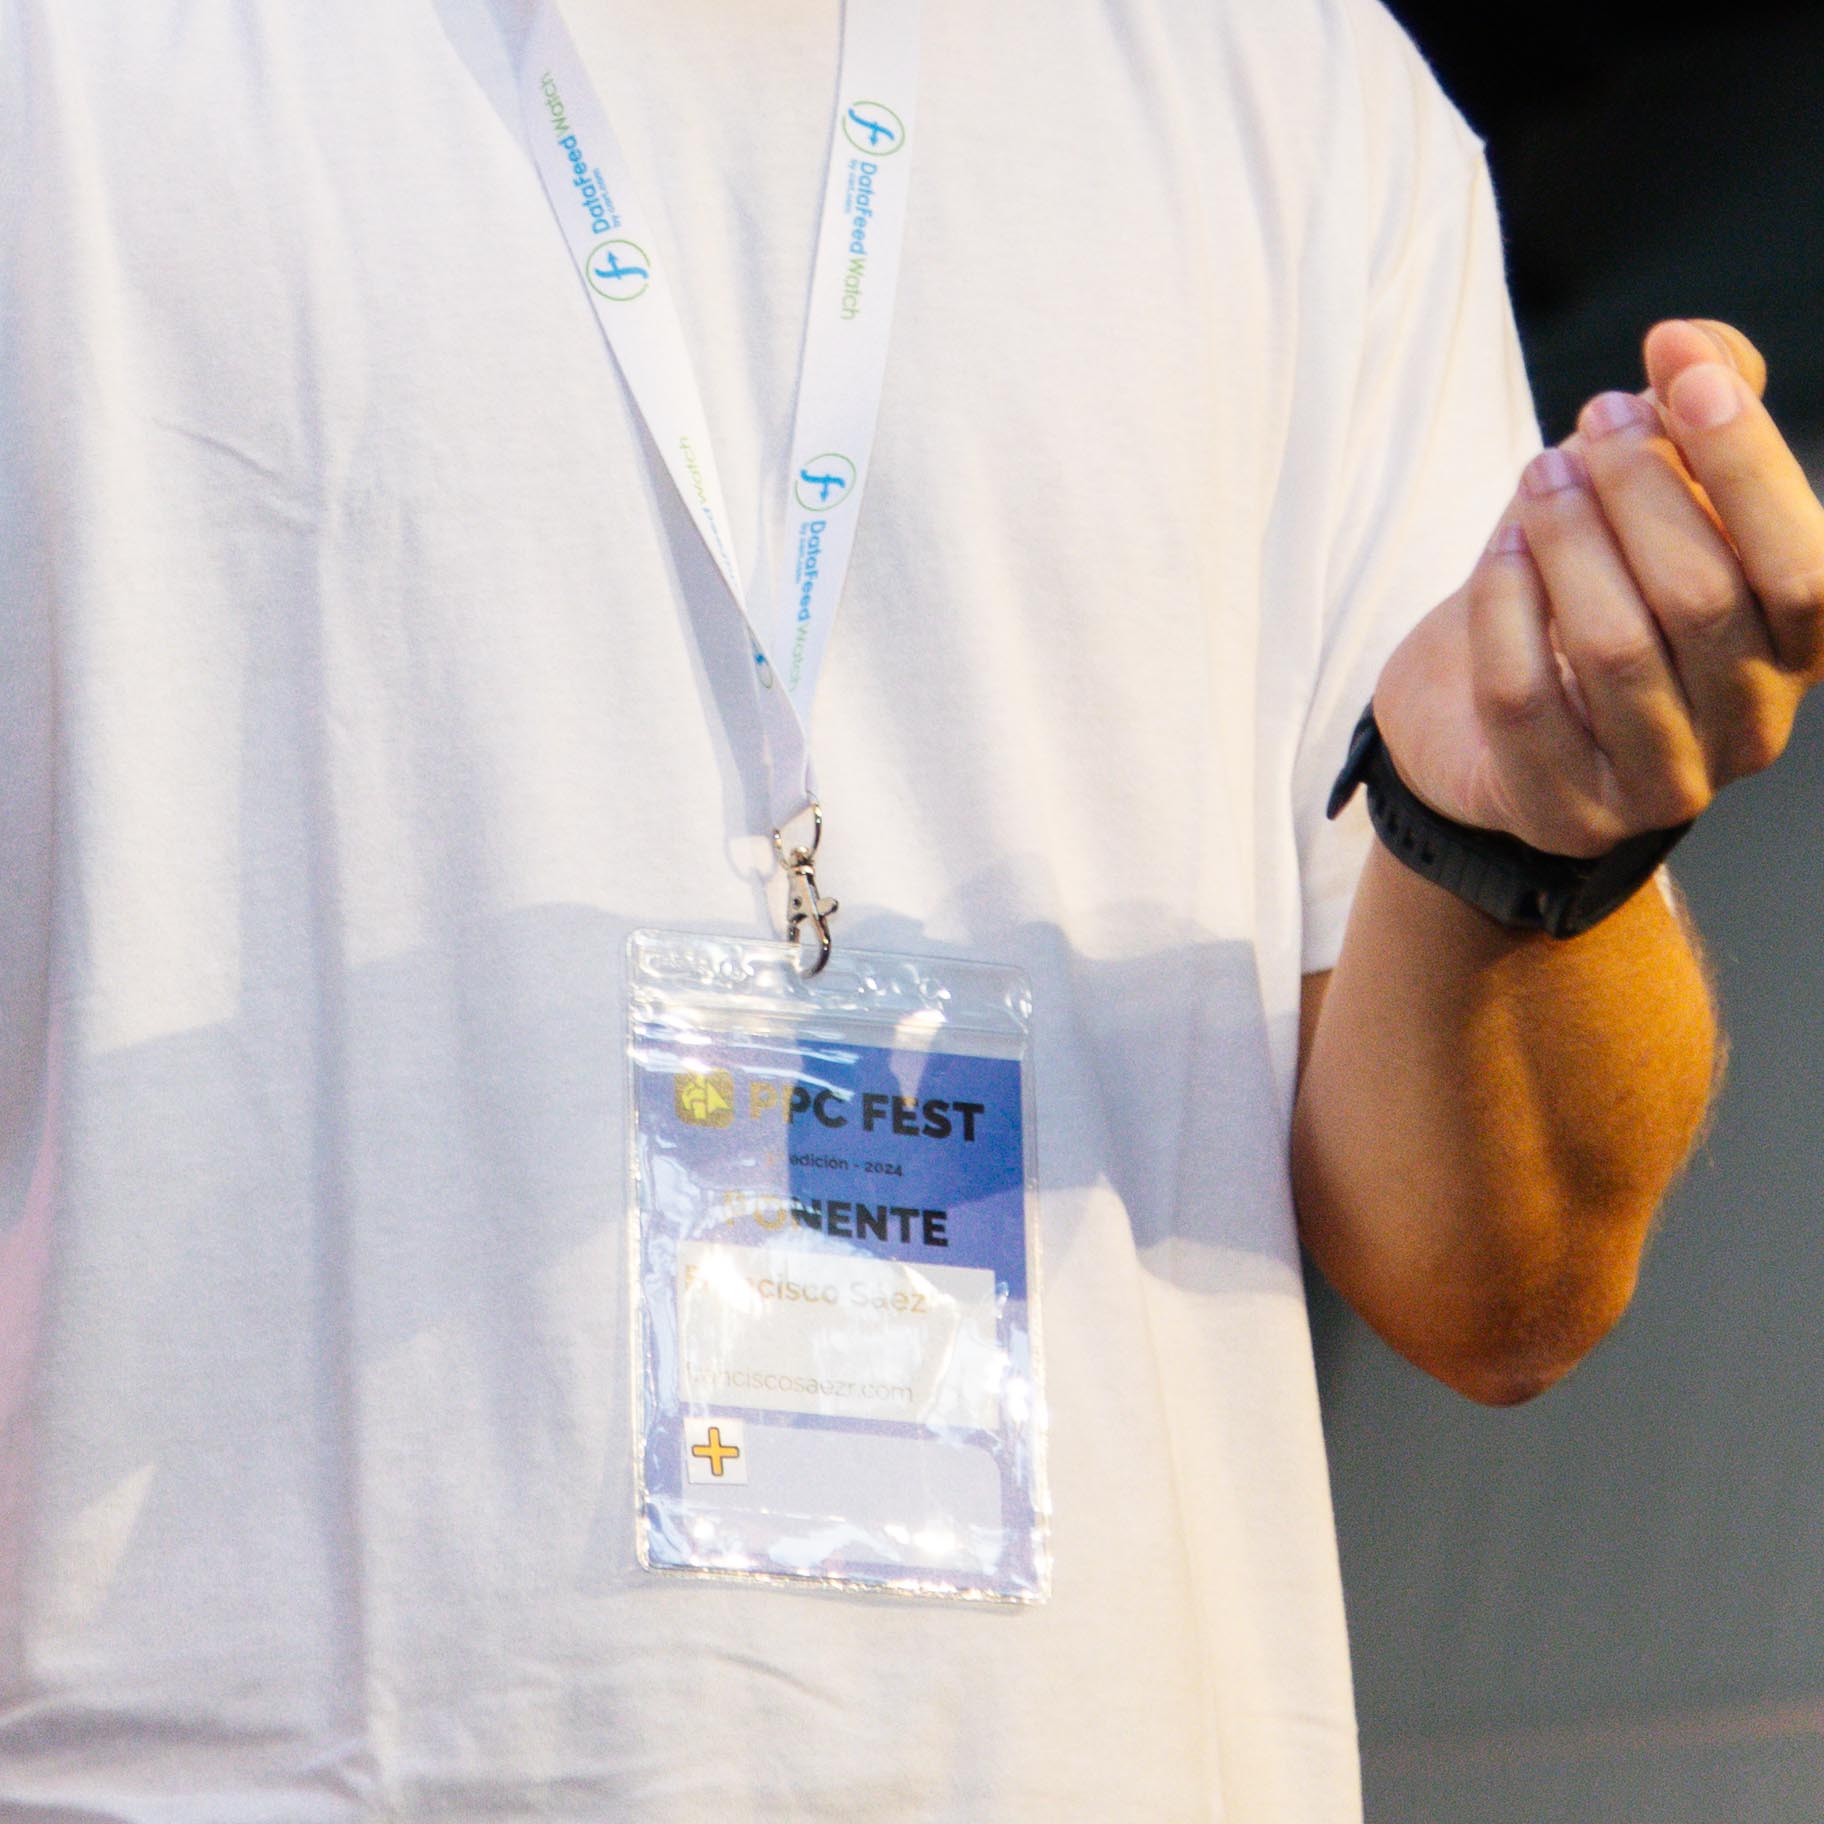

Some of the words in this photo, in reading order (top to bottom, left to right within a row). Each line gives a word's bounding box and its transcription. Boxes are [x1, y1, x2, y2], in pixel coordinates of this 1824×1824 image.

[749, 1081, 849, 1129] PPC
[862, 1091, 985, 1143] FEST
[864, 1160, 904, 1178] 2024
